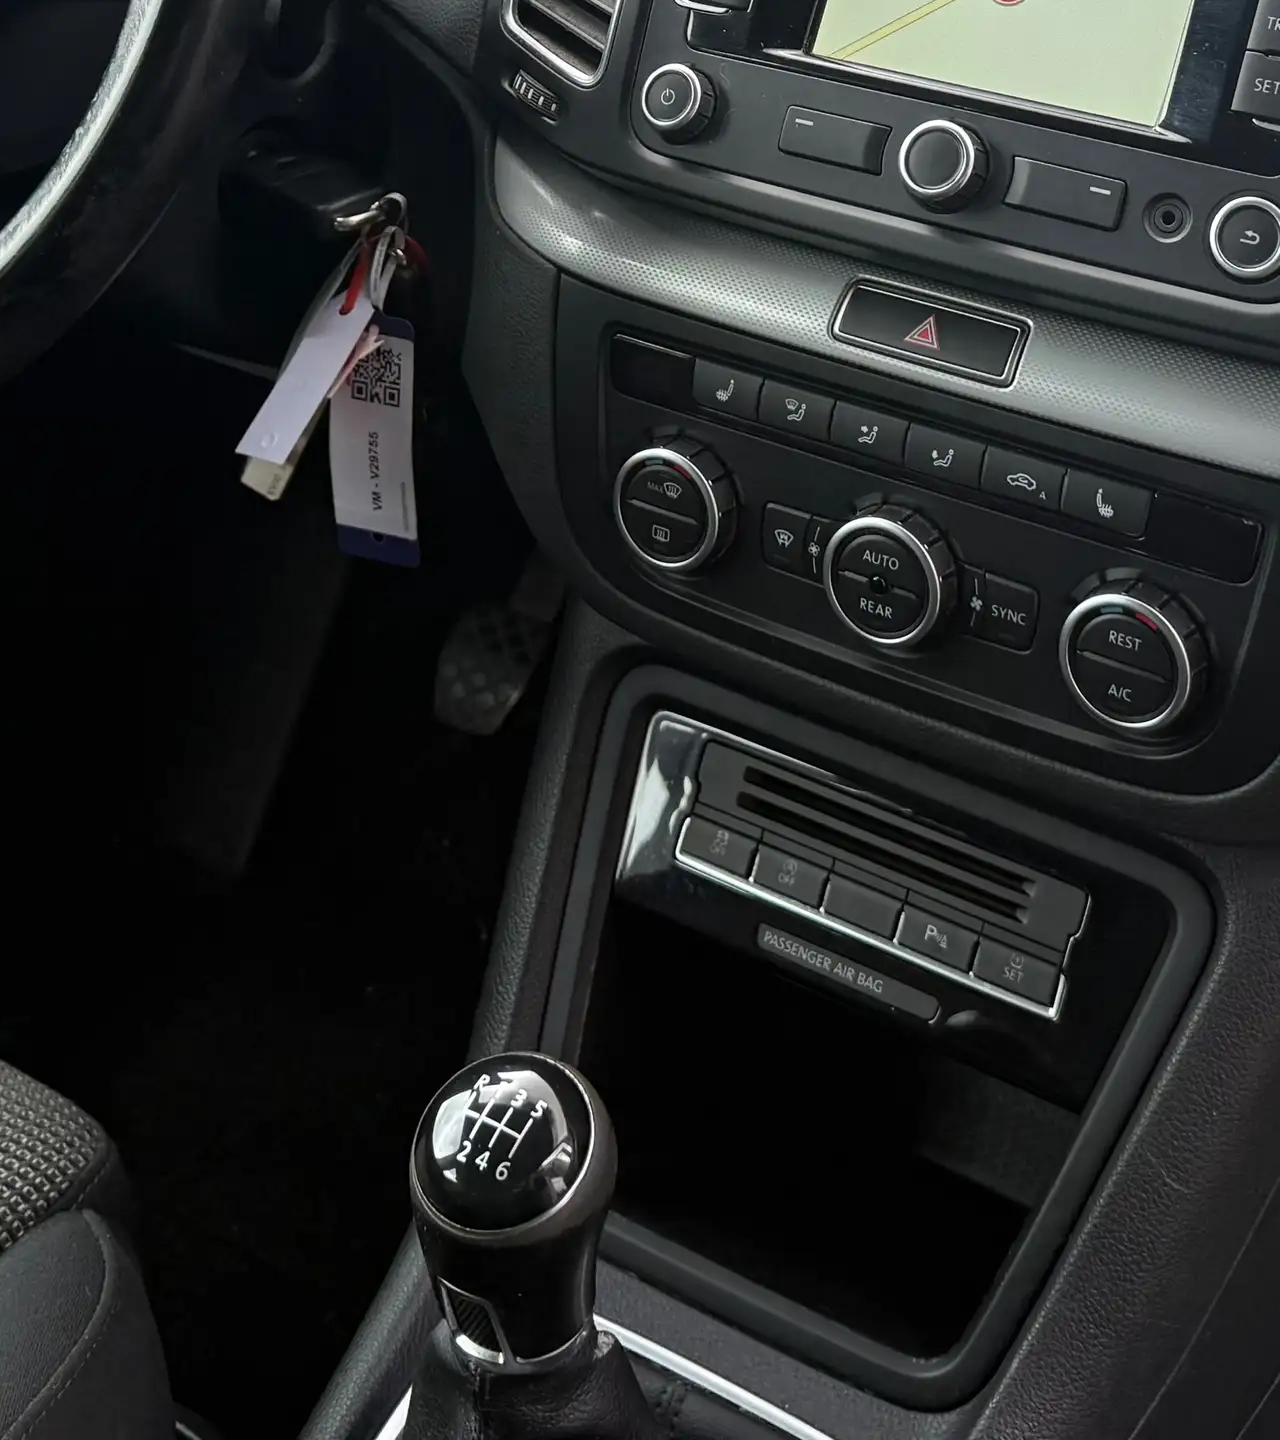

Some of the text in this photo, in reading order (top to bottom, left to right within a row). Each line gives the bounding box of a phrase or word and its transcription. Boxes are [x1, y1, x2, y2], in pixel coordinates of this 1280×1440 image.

[368, 431, 380, 480] V29755
[646, 481, 664, 494] MAX
[372, 490, 382, 512] VM
[862, 550, 900, 571] AUTO
[860, 598, 893, 620] REAR
[991, 604, 1028, 626] SYNC
[1108, 630, 1142, 651] REST
[1108, 684, 1133, 703] A/C
[778, 872, 795, 886] OFF
[764, 930, 884, 993] PASSENGER AIR BAG
[1003, 966, 1024, 983] SET
[473, 1073, 490, 1090] R
[510, 1088, 528, 1108] 3
[530, 1100, 548, 1117] 5
[456, 1140, 472, 1163] 2
[474, 1150, 491, 1171] 4
[494, 1161, 511, 1181] 6
